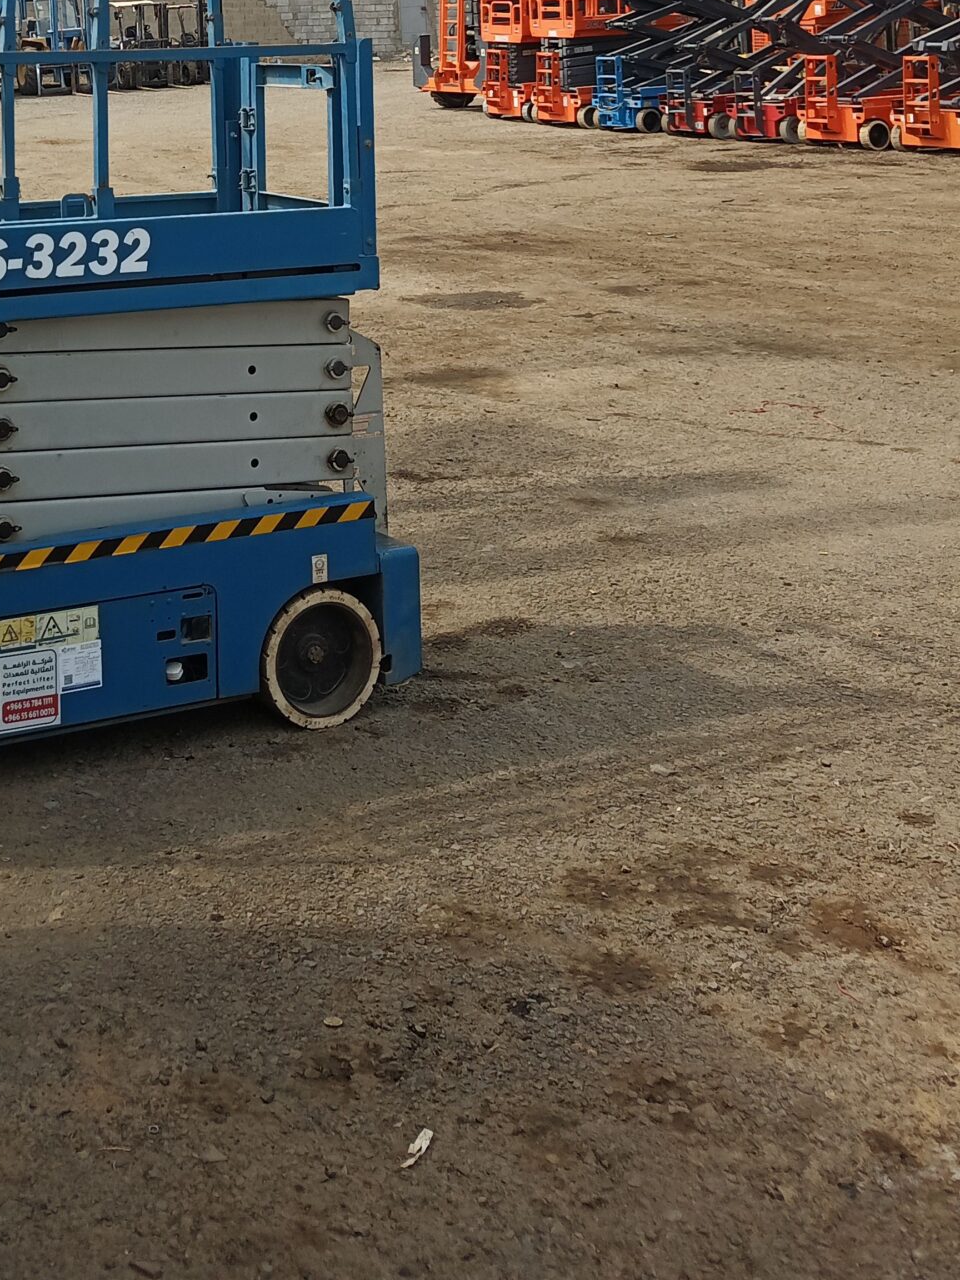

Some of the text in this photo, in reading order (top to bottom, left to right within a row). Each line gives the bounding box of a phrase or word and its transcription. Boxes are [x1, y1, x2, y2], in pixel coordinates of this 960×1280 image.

[2, 679, 31, 689] Perfect
[12, 685, 45, 696] Equipment
[6, 701, 23, 711] +966
[23, 700, 31, 709] 56
[5, 713, 21, 722] +966
